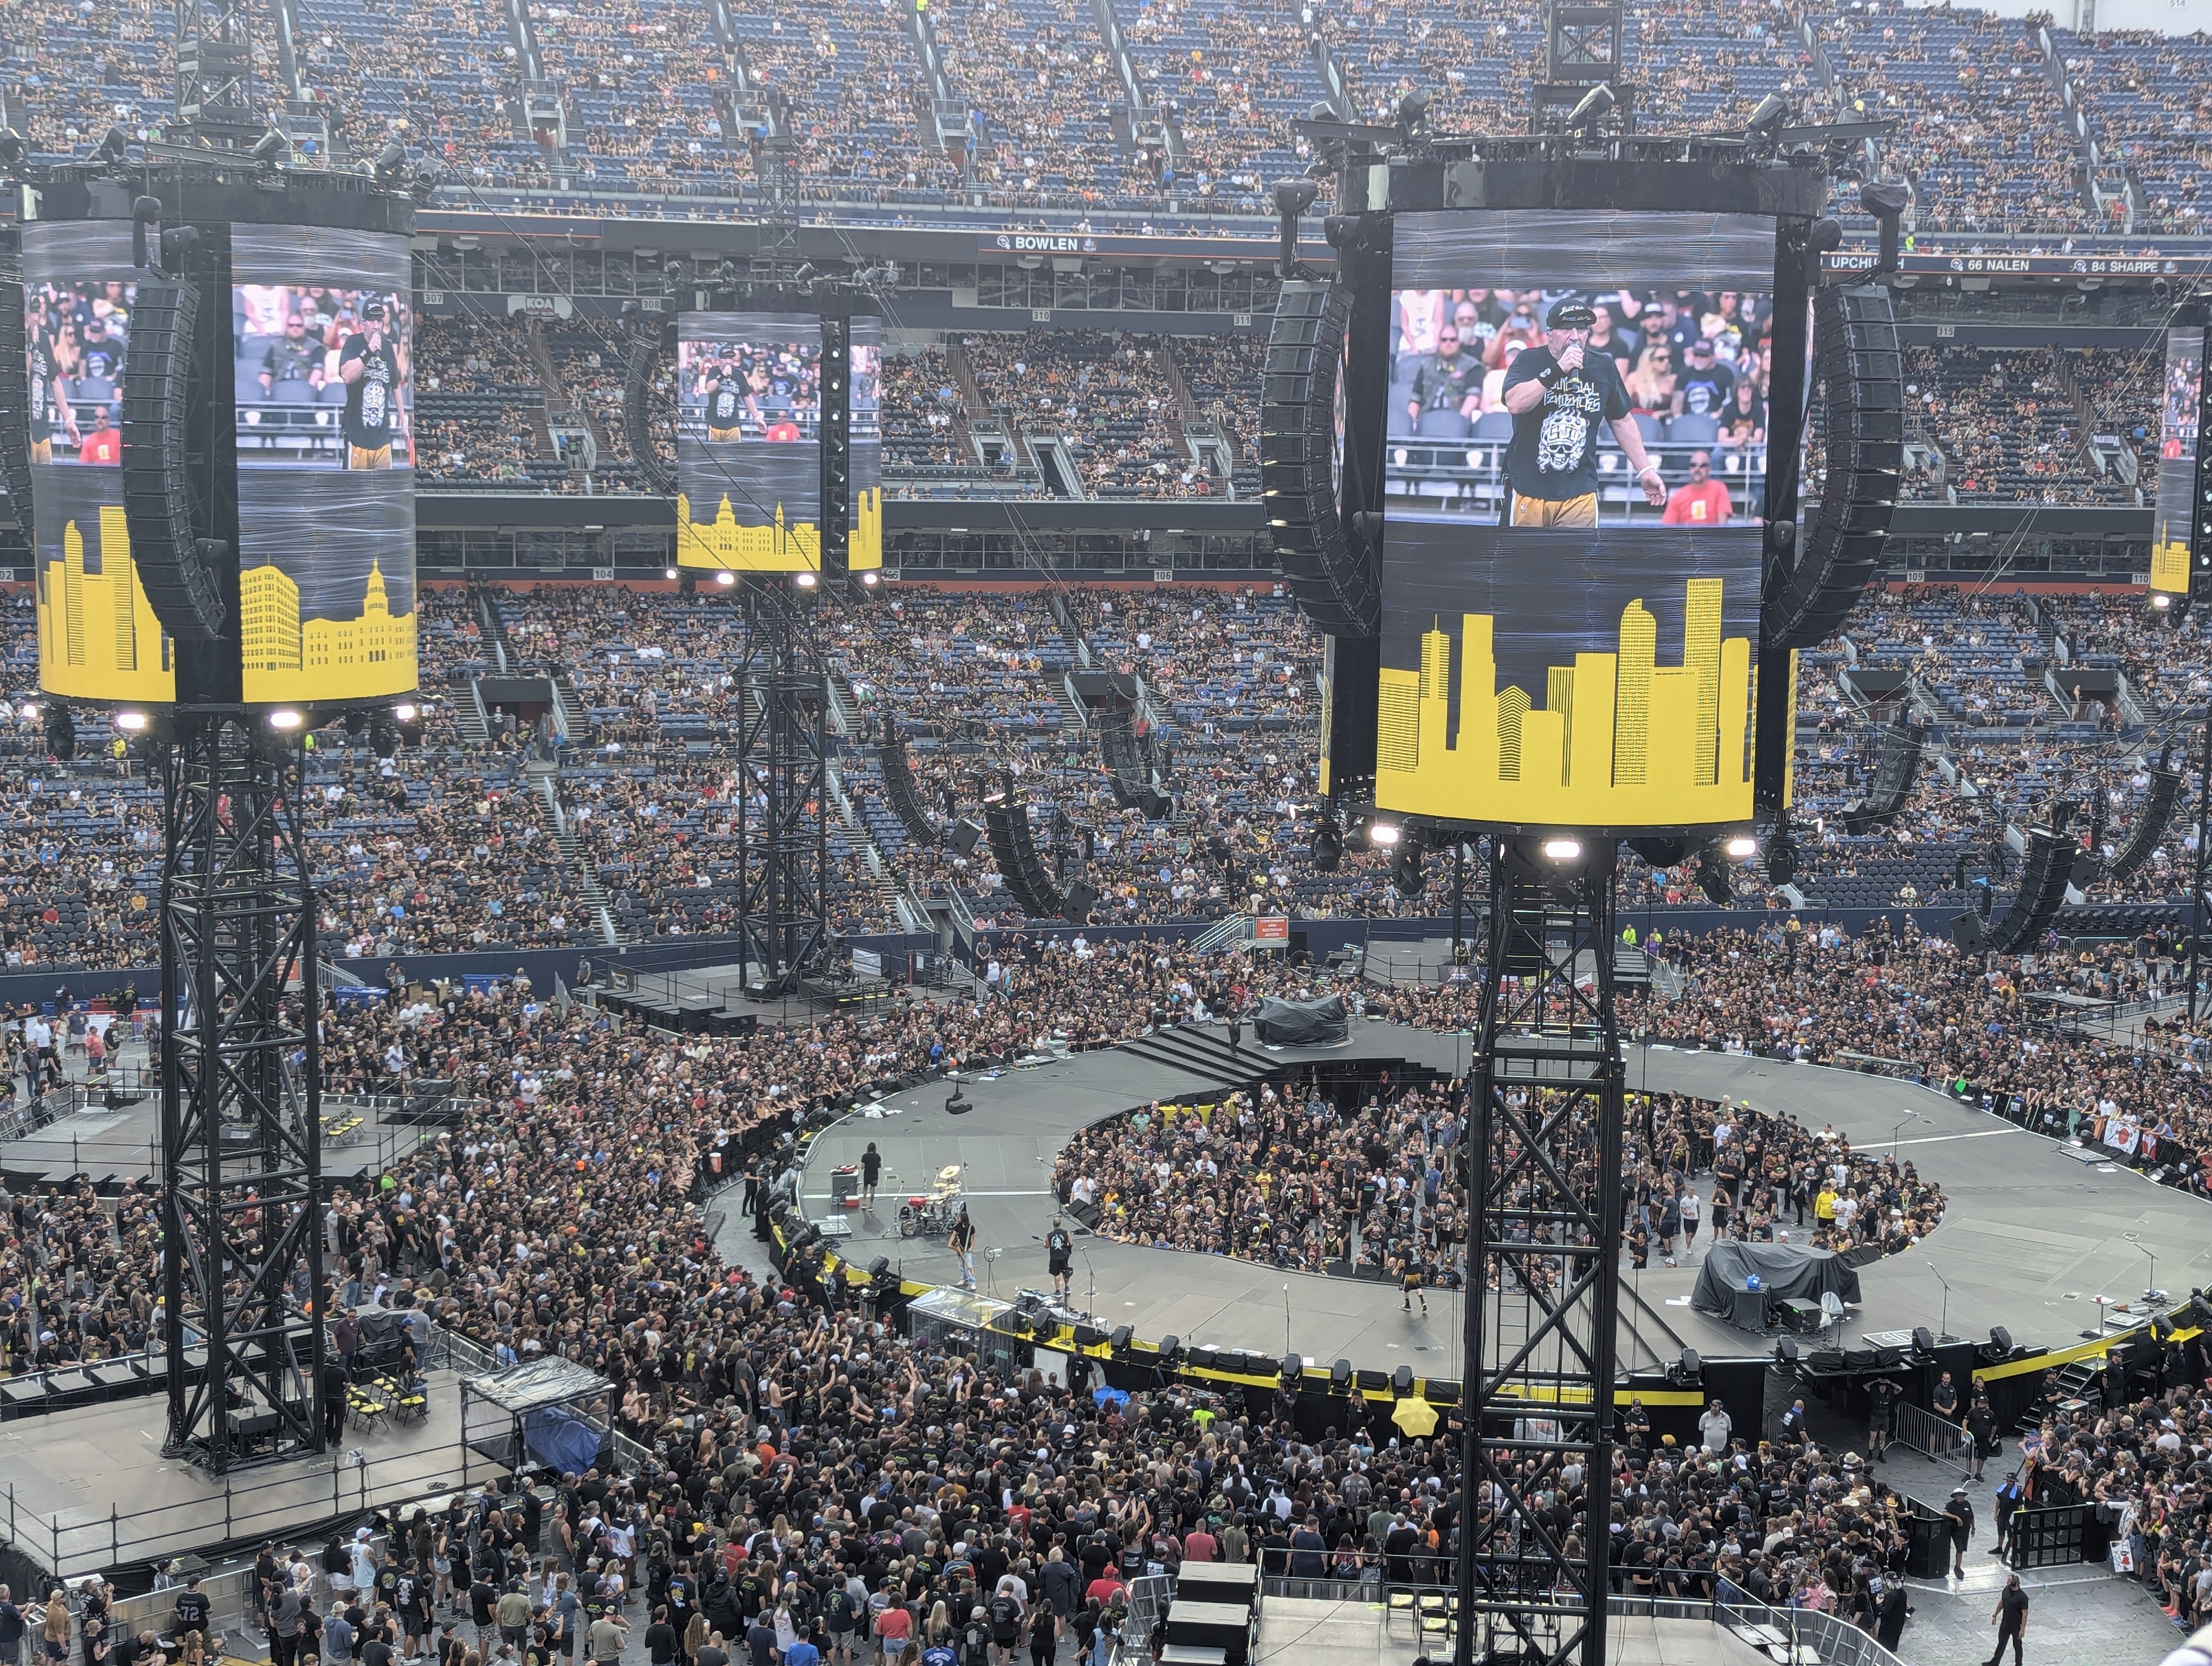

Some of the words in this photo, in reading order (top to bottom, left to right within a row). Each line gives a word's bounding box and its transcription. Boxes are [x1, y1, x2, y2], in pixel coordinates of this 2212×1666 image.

[1015, 236, 1077, 251] BOWLEN
[1968, 260, 1982, 270] 66
[1986, 260, 2029, 271] NALEN
[2091, 261, 2105, 272] 84
[2110, 261, 2159, 273] SHARPE
[425, 293, 443, 303] 307
[527, 298, 554, 309] KOA
[643, 300, 660, 309] 308
[1034, 311, 1049, 319] 310
[1234, 316, 1250, 324] 311
[595, 570, 612, 579] 104
[1155, 572, 1171, 580] 106
[1908, 573, 1923, 581] 109
[2134, 575, 2149, 583] 110
[181, 1606, 200, 1622] 72
